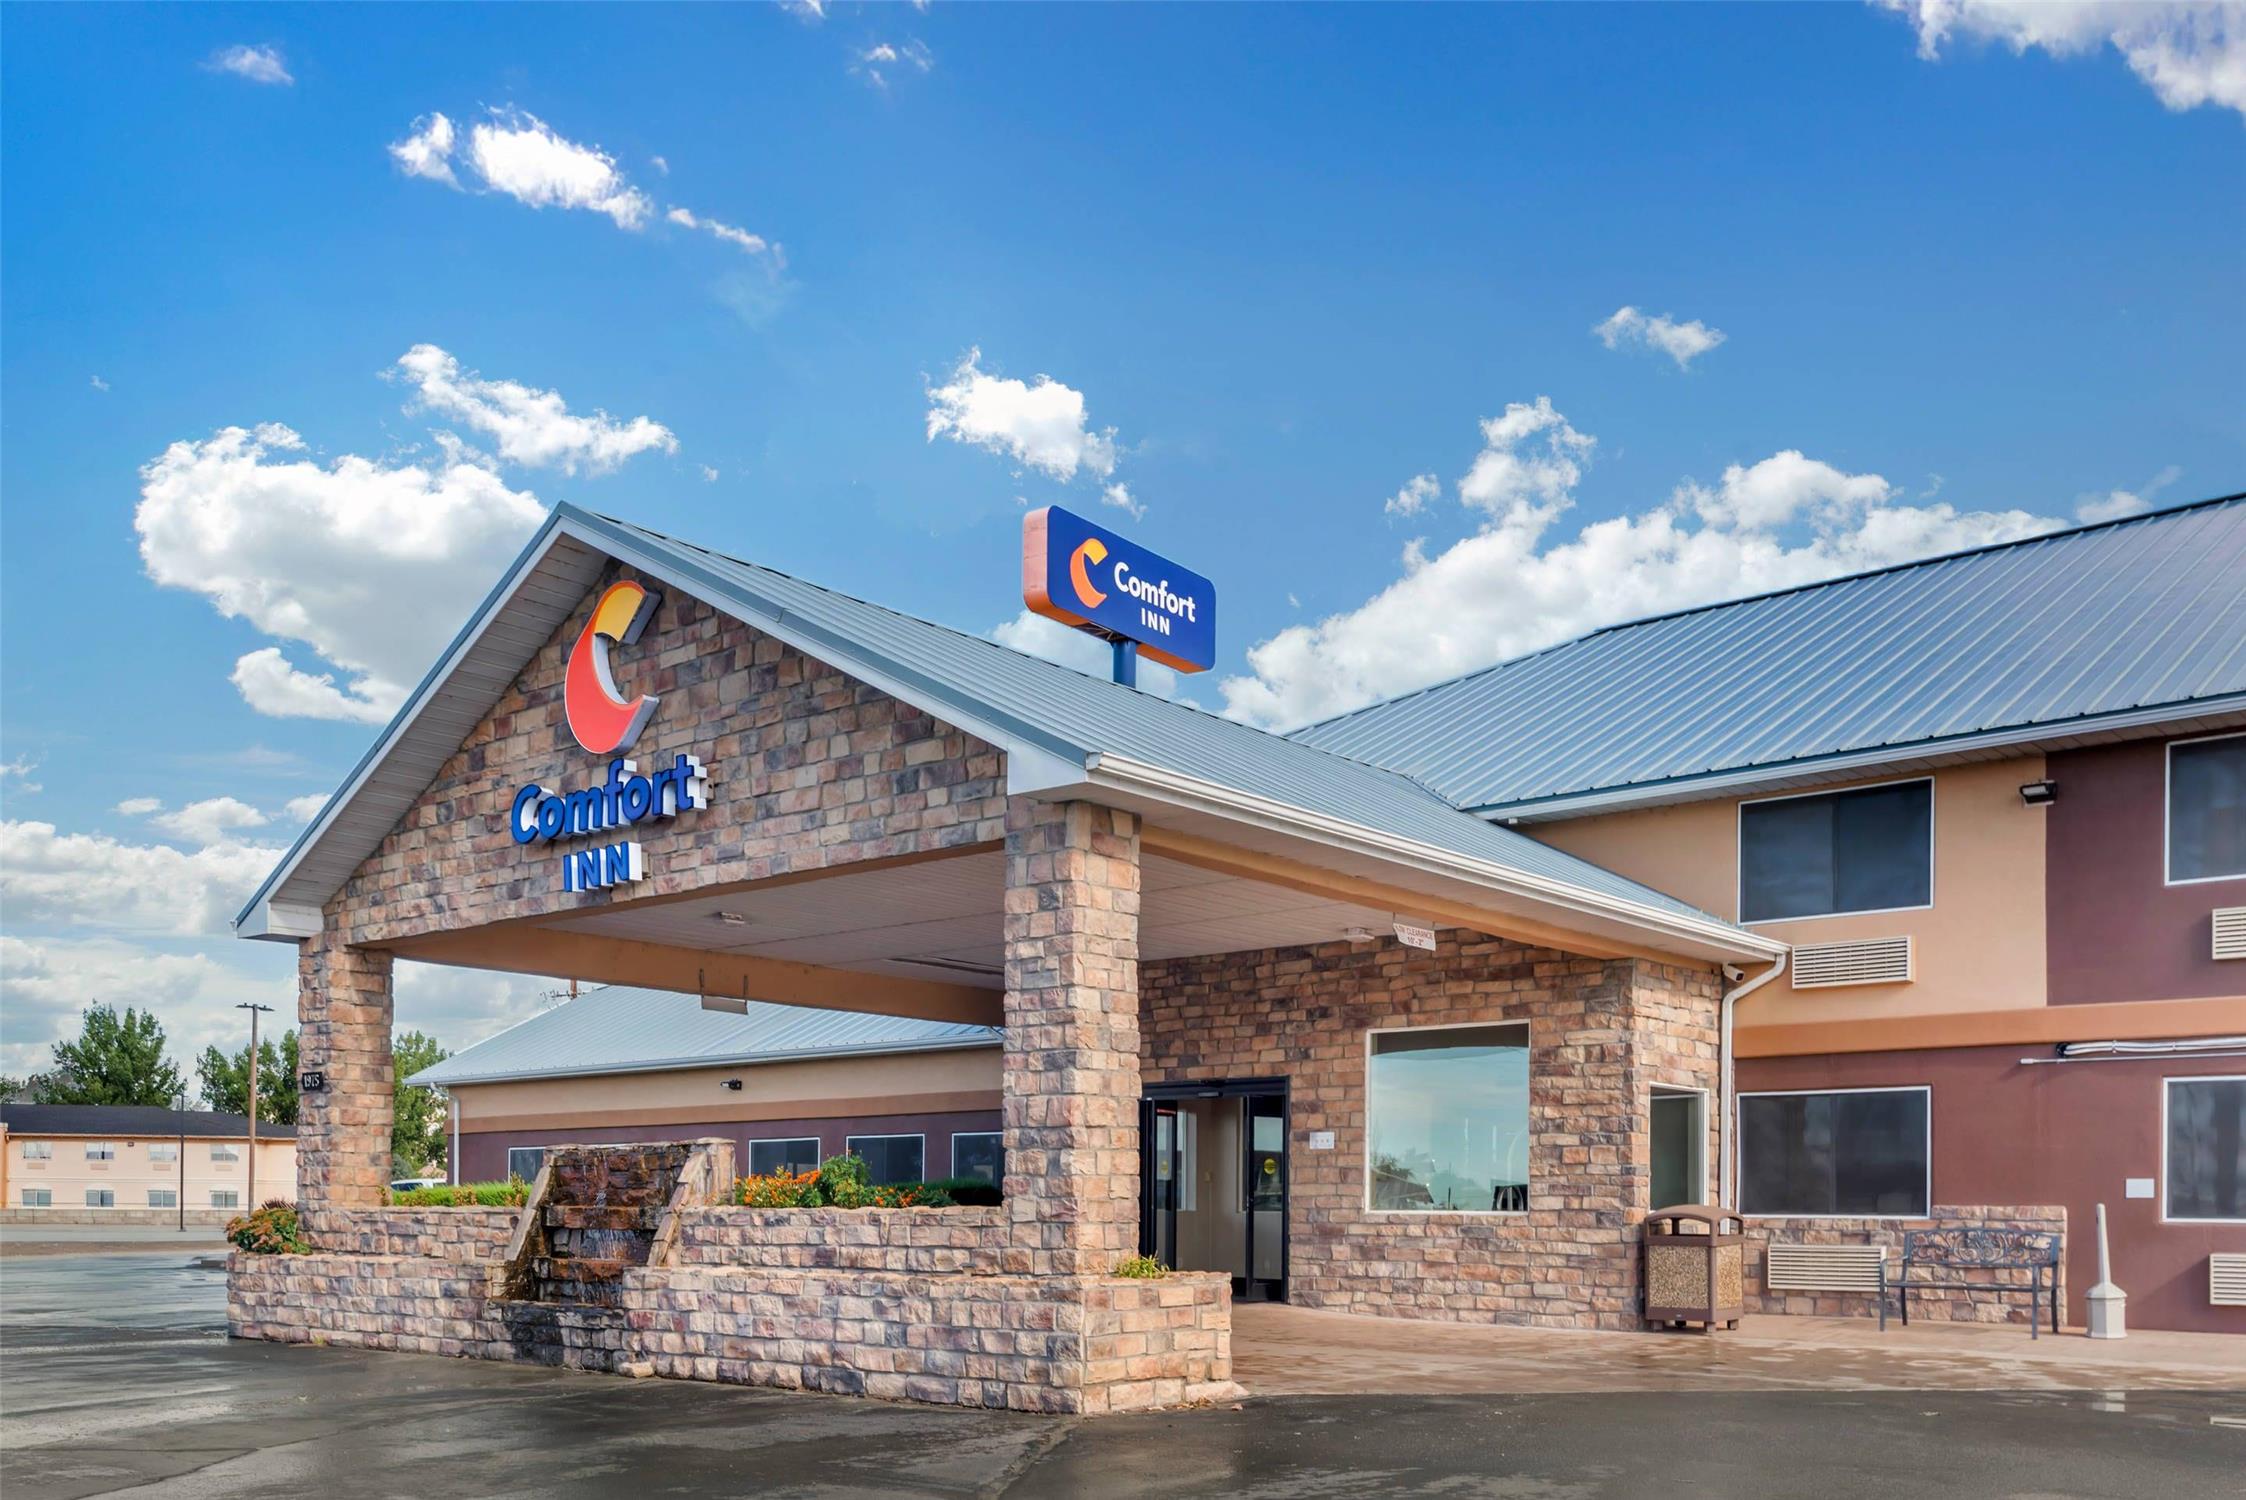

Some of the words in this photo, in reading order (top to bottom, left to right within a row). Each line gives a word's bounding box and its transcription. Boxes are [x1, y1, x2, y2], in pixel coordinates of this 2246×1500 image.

[1114, 561, 1196, 622] Comfort
[1141, 608, 1170, 636] INN
[511, 754, 698, 844] Comfort
[563, 841, 631, 892] INN
[1407, 928, 1434, 940] CLEARANCE
